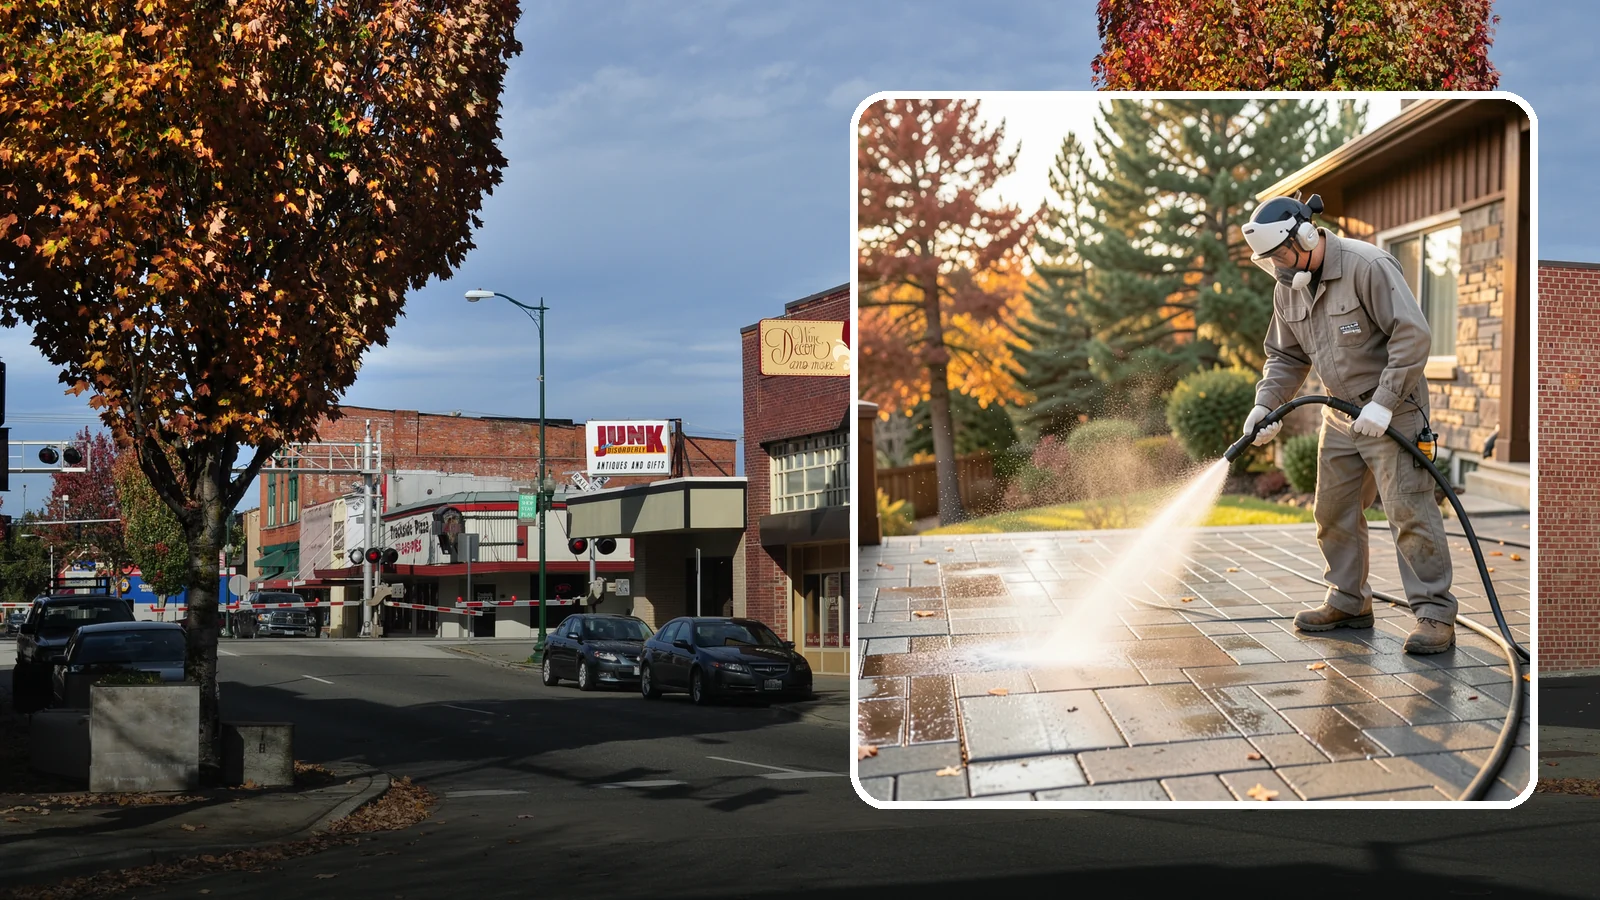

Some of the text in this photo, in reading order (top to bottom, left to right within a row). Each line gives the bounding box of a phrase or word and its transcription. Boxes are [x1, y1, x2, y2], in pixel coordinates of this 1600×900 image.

[595, 425, 665, 457] JUNK
[607, 446, 646, 454] DISORDERLY
[596, 460, 666, 470] ANTIQUES AND GIFTS
[573, 473, 589, 492] RAIL
[414, 519, 429, 535] Pizza
